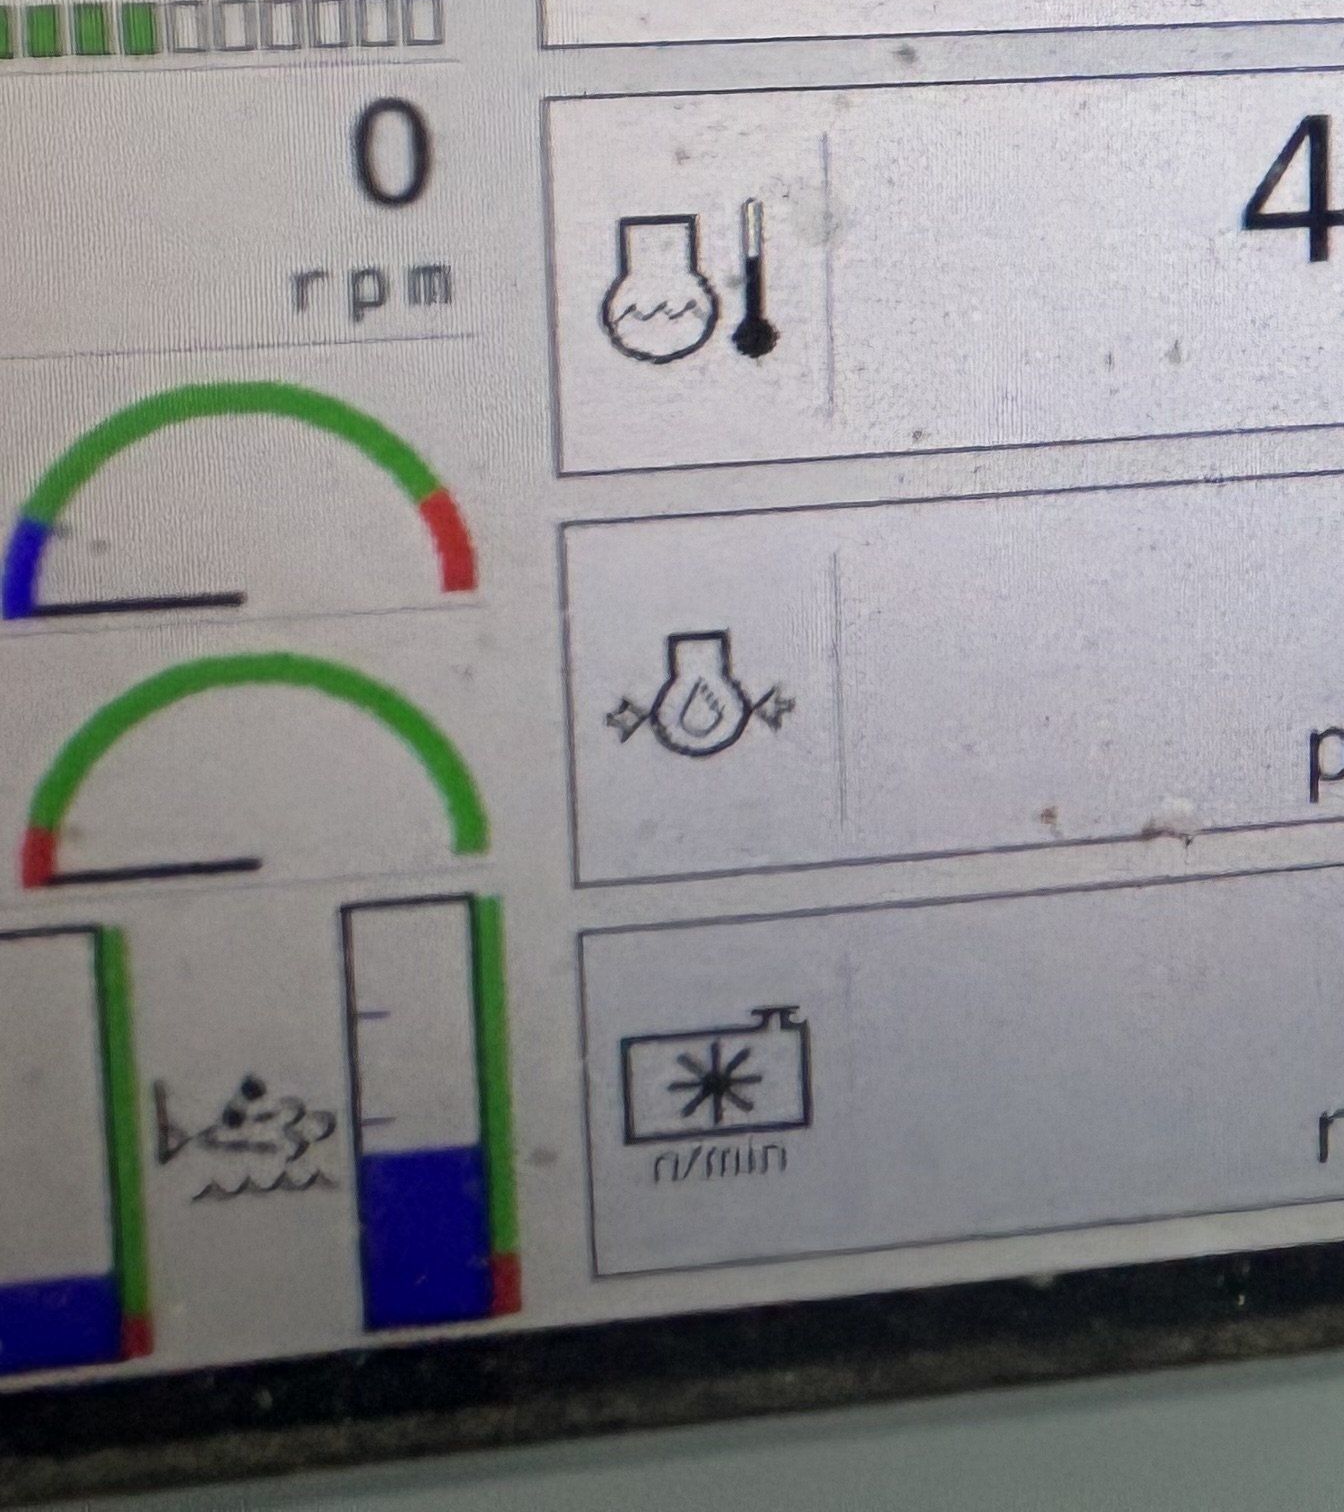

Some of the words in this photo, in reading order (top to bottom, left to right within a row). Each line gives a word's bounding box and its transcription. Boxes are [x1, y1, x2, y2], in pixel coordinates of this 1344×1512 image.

[352, 96, 431, 209] 0
[292, 263, 452, 324] rpm
[652, 1140, 788, 1184] n/min
